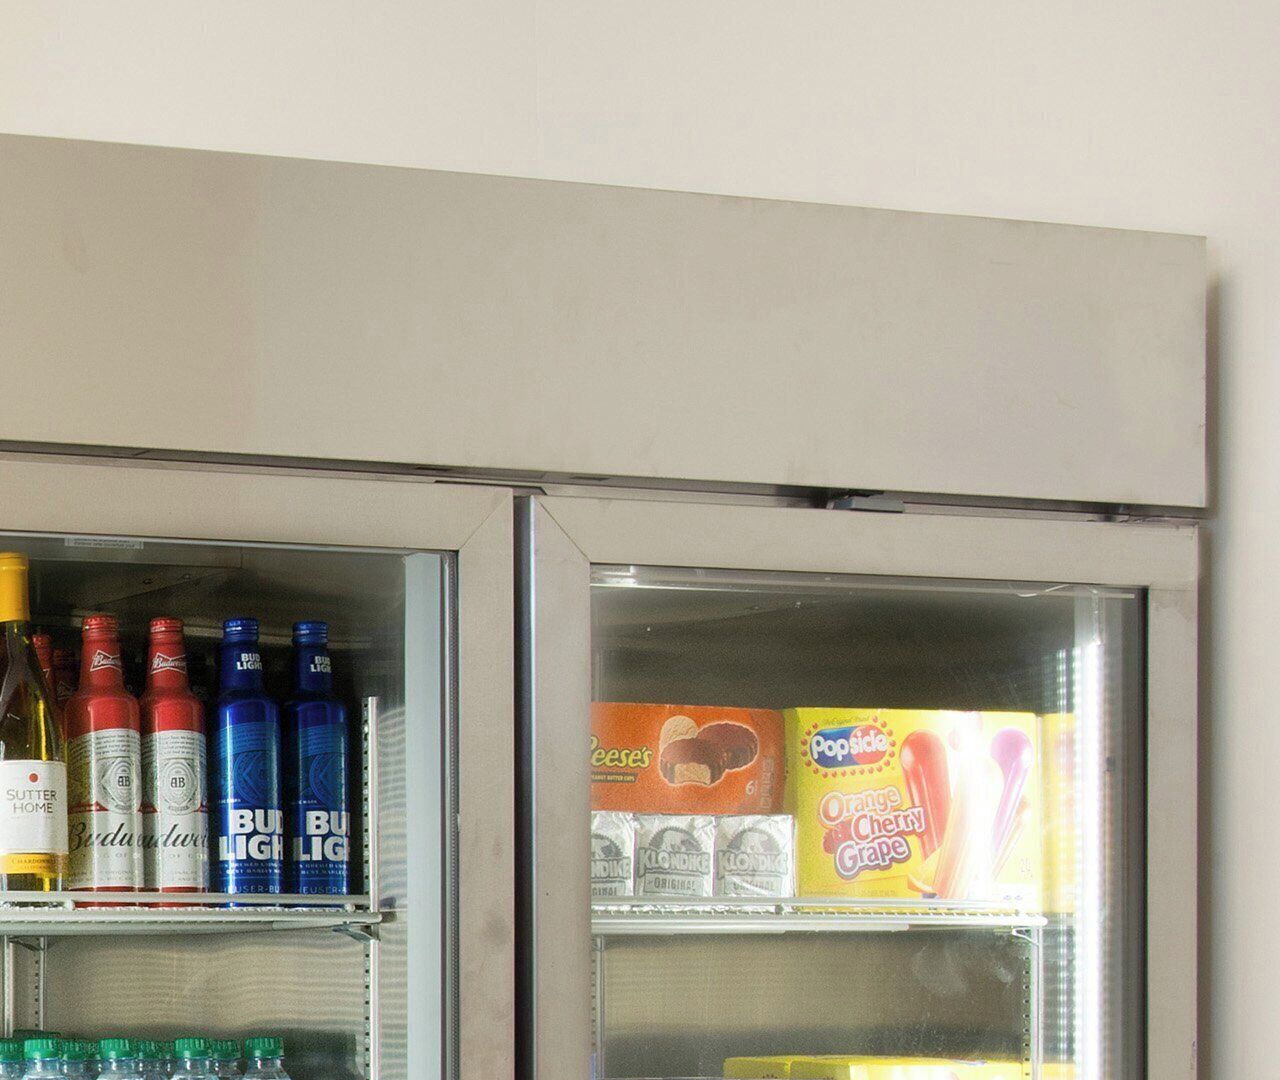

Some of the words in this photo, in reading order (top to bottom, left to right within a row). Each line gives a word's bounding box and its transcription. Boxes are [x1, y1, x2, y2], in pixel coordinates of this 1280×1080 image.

[810, 731, 888, 761] Popsicle
[6, 788, 58, 802] SUTTER
[13, 801, 55, 814] HOME
[820, 785, 902, 824] Orange
[851, 807, 925, 842] Cherry
[642, 850, 711, 869] KLONDIKE
[836, 837, 909, 876] Grape
